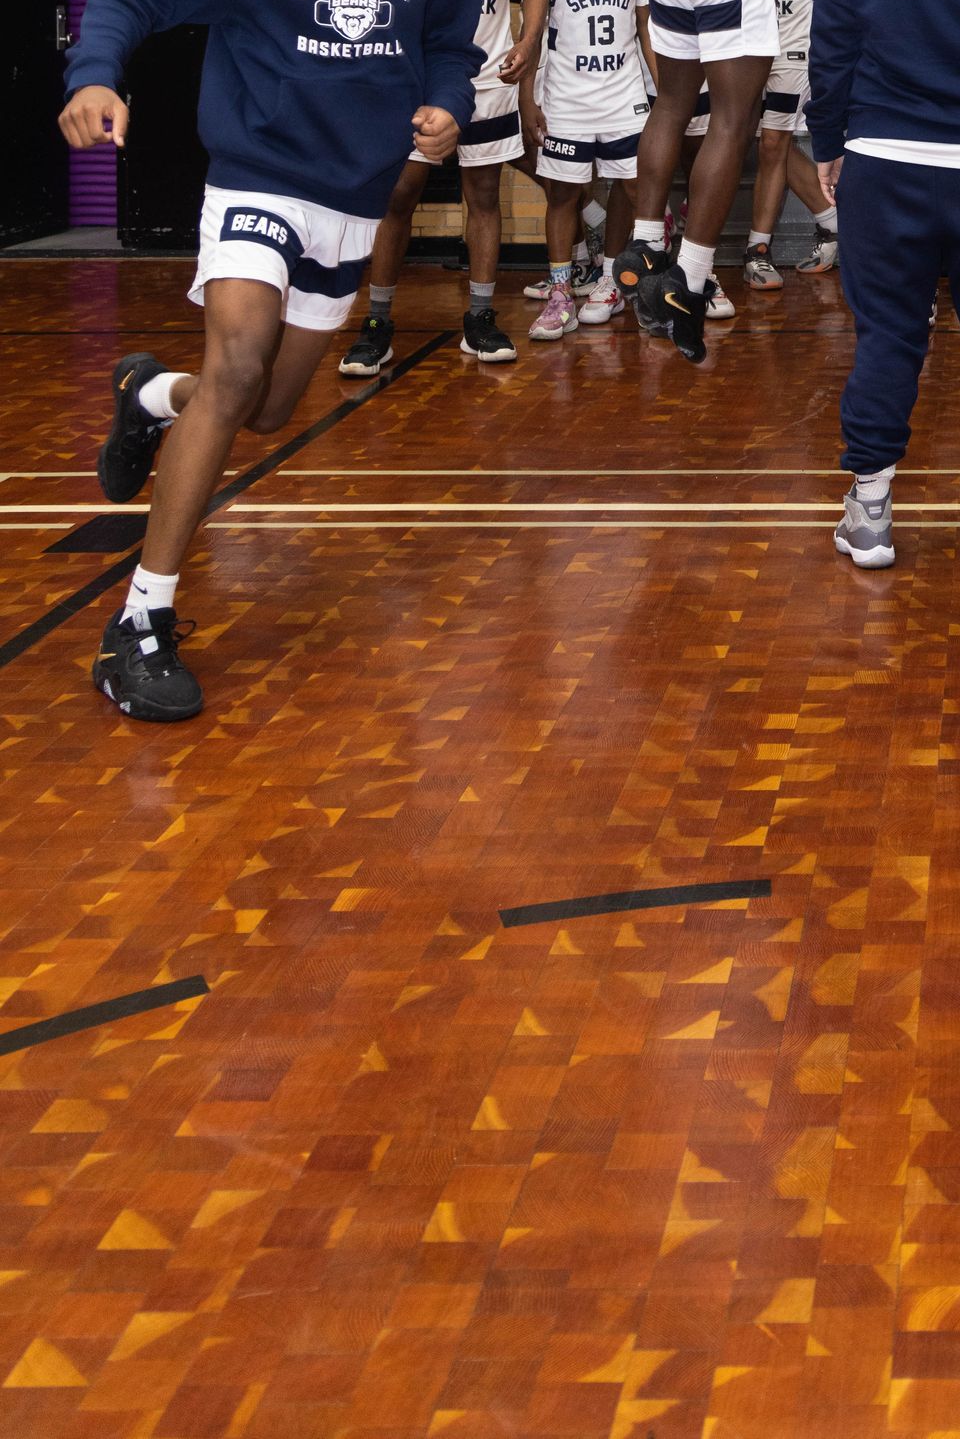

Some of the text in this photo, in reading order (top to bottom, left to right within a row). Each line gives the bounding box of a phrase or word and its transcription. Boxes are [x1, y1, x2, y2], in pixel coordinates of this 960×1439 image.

[587, 14, 615, 46] 13
[296, 35, 404, 58] BASKETBALL
[575, 52, 626, 72] PARK
[544, 138, 576, 156] BEARS
[230, 214, 289, 246] BEARS
